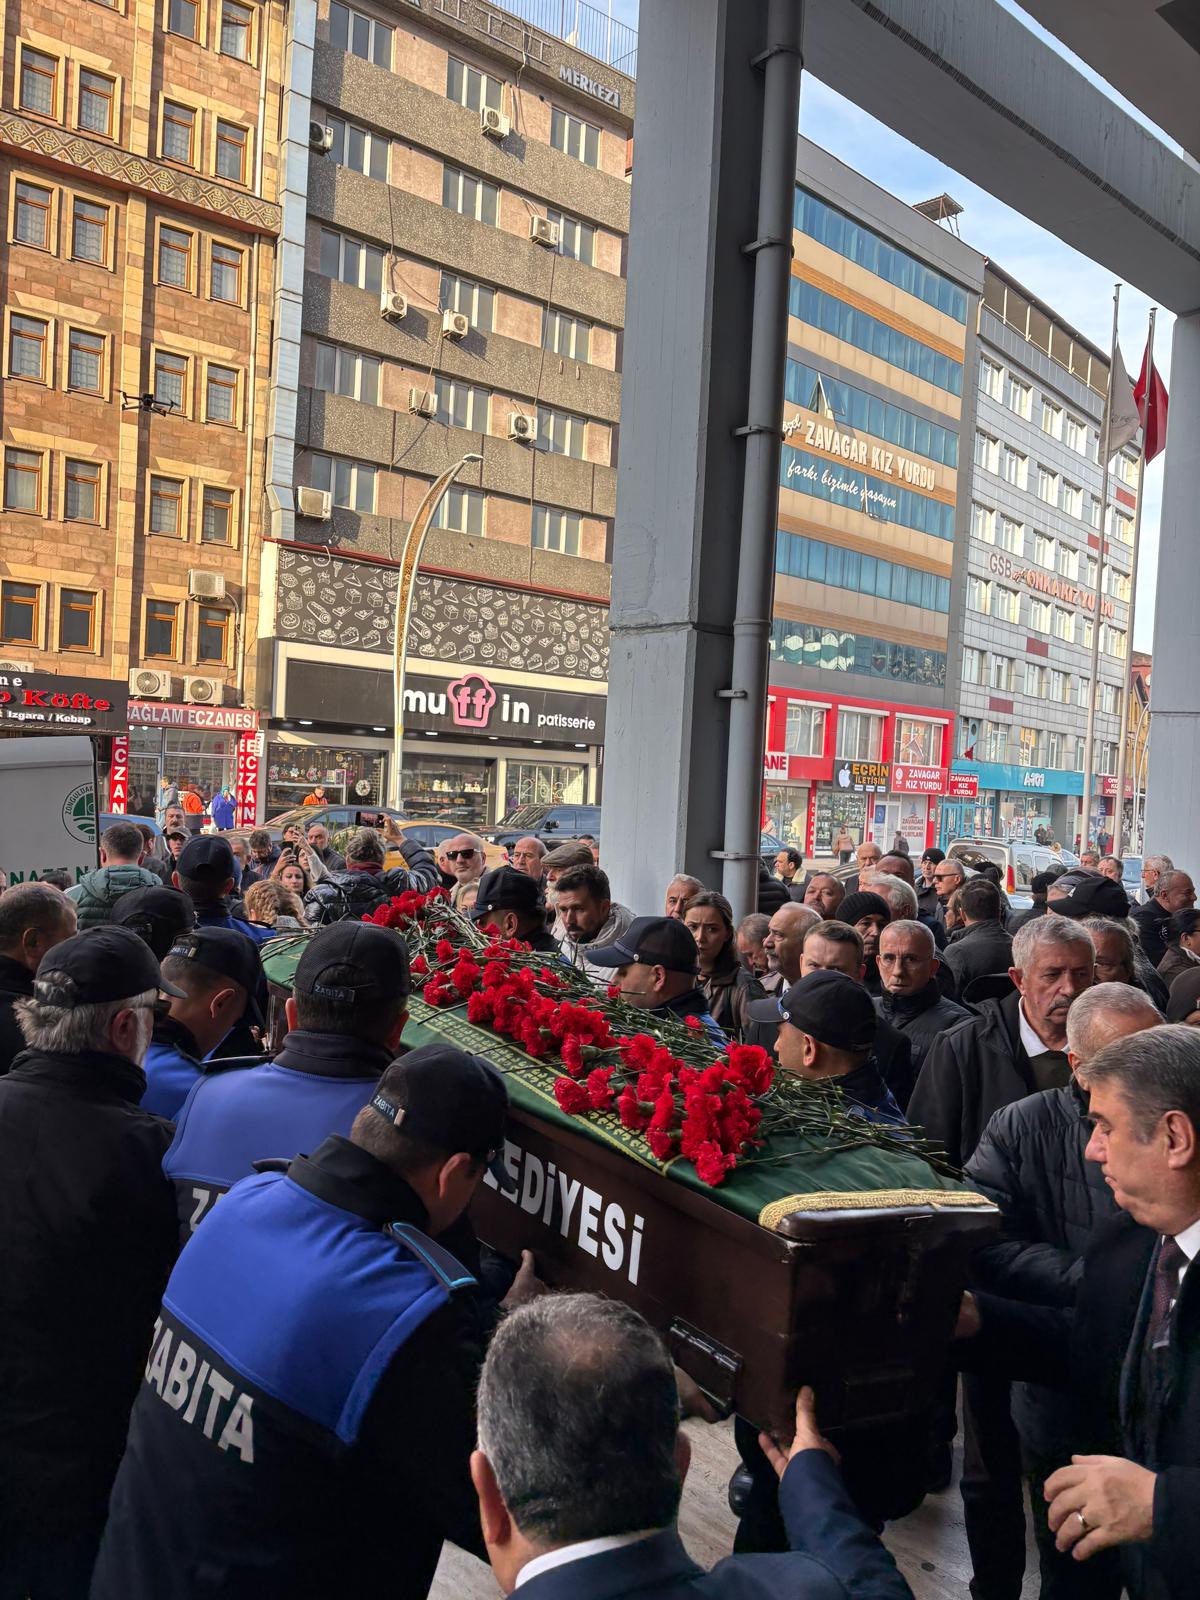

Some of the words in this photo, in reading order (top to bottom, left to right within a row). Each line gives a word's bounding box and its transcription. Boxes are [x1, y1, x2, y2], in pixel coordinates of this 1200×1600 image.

[805, 419, 868, 466] ZAVAGAR
[871, 446, 893, 475] KIZ
[897, 456, 936, 492] YURDU
[821, 469, 859, 495] bizimle
[990, 553, 1012, 579] GSB
[21, 689, 111, 711] Köfte
[55, 713, 91, 725] Kebap
[537, 713, 596, 730] patisserie
[908, 769, 940, 780] ZAVAGAR
[905, 780, 918, 789] KIZ
[919, 781, 942, 790] YURDU
[314, 984, 345, 999] ZABITA
[374, 1095, 396, 1117] ZABITA
